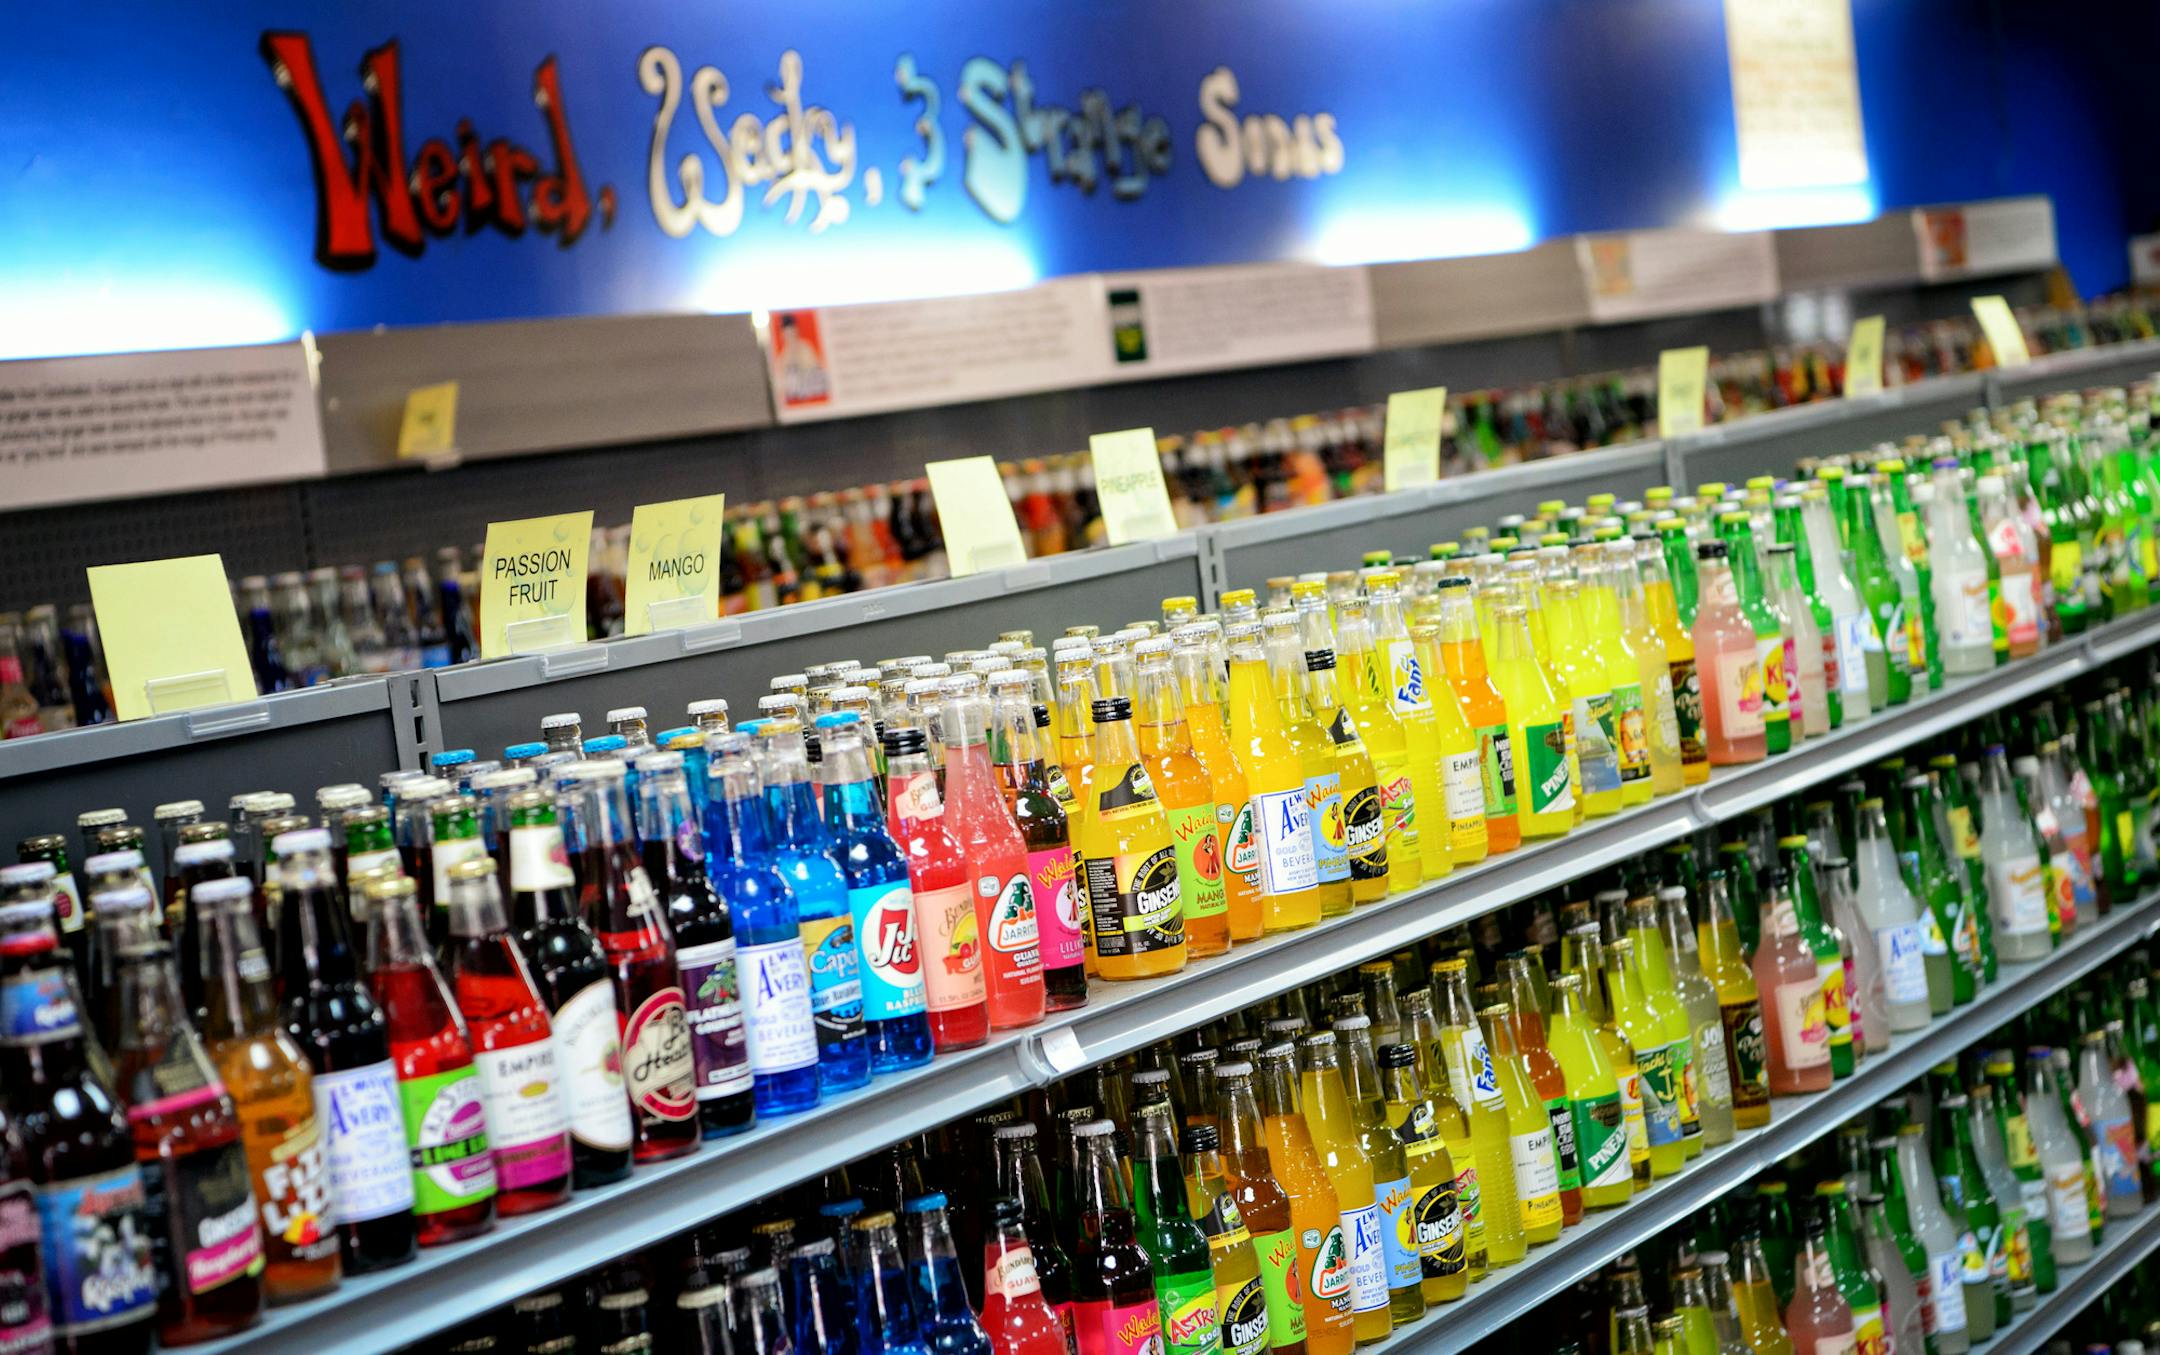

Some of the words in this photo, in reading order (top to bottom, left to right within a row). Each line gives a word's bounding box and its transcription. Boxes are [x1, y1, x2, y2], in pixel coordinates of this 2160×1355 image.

[1101, 470, 1158, 496] PINEAPPLE
[495, 549, 571, 579] PASSION
[649, 554, 704, 582] MANGO
[509, 579, 558, 606] FRUIT
[1169, 1308, 1214, 1345] ASTRO
